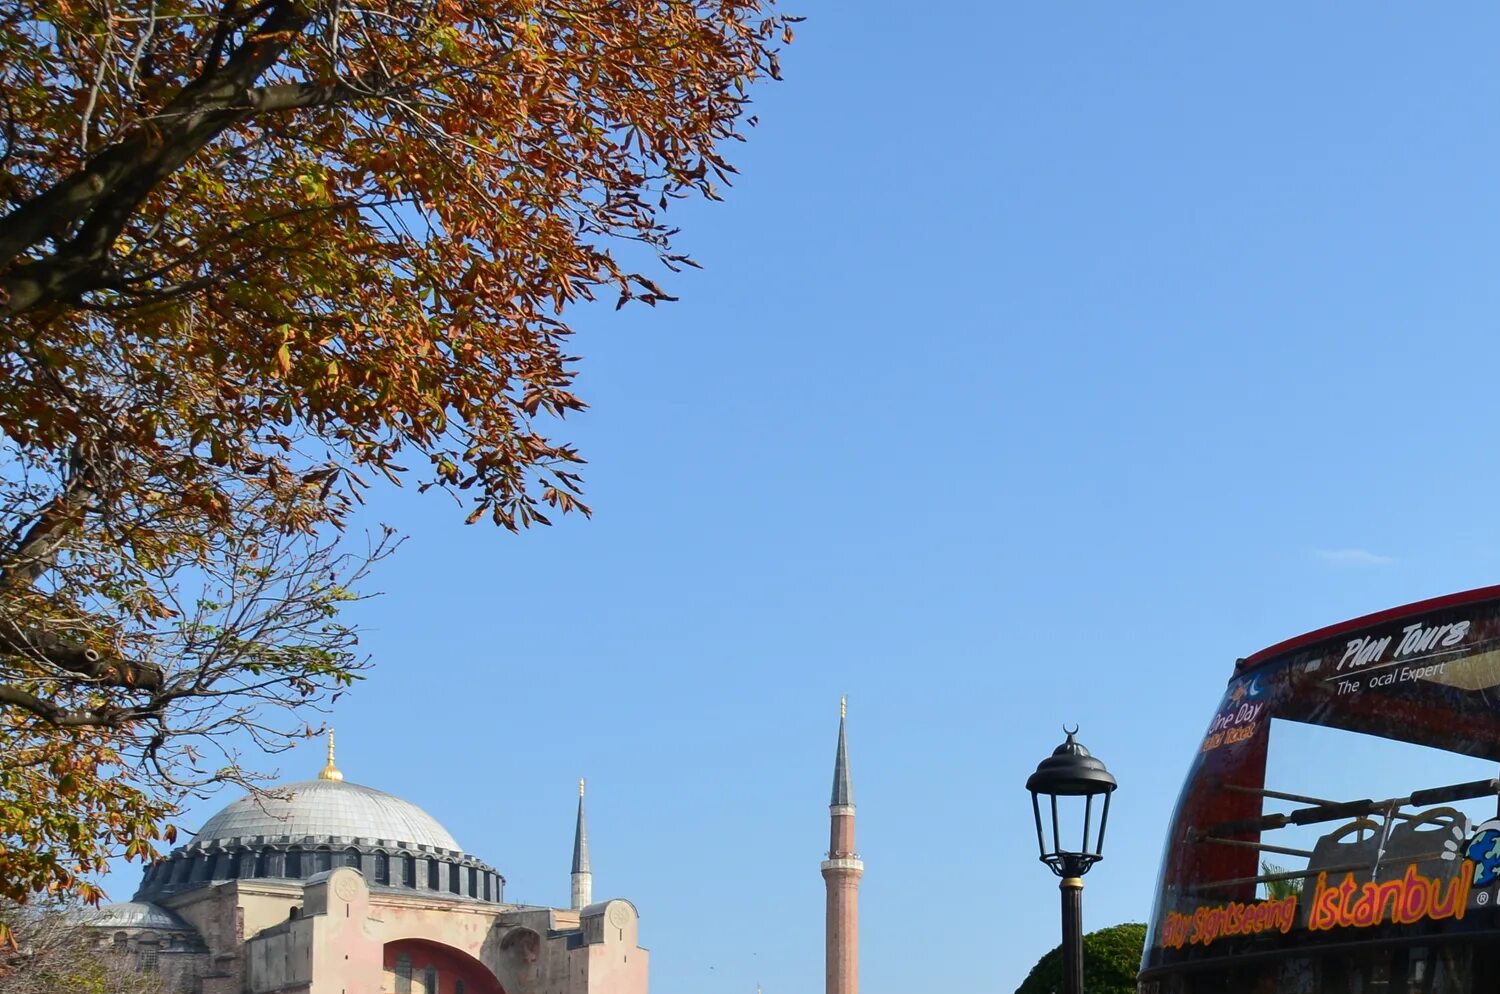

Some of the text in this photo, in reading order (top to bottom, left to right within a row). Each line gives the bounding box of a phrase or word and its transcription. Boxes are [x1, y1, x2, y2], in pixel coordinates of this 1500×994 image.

[1336, 620, 1471, 671] Plan Tours
[1337, 680, 1361, 696] The
[1400, 662, 1446, 682] Expert
[1235, 702, 1263, 724] Day
